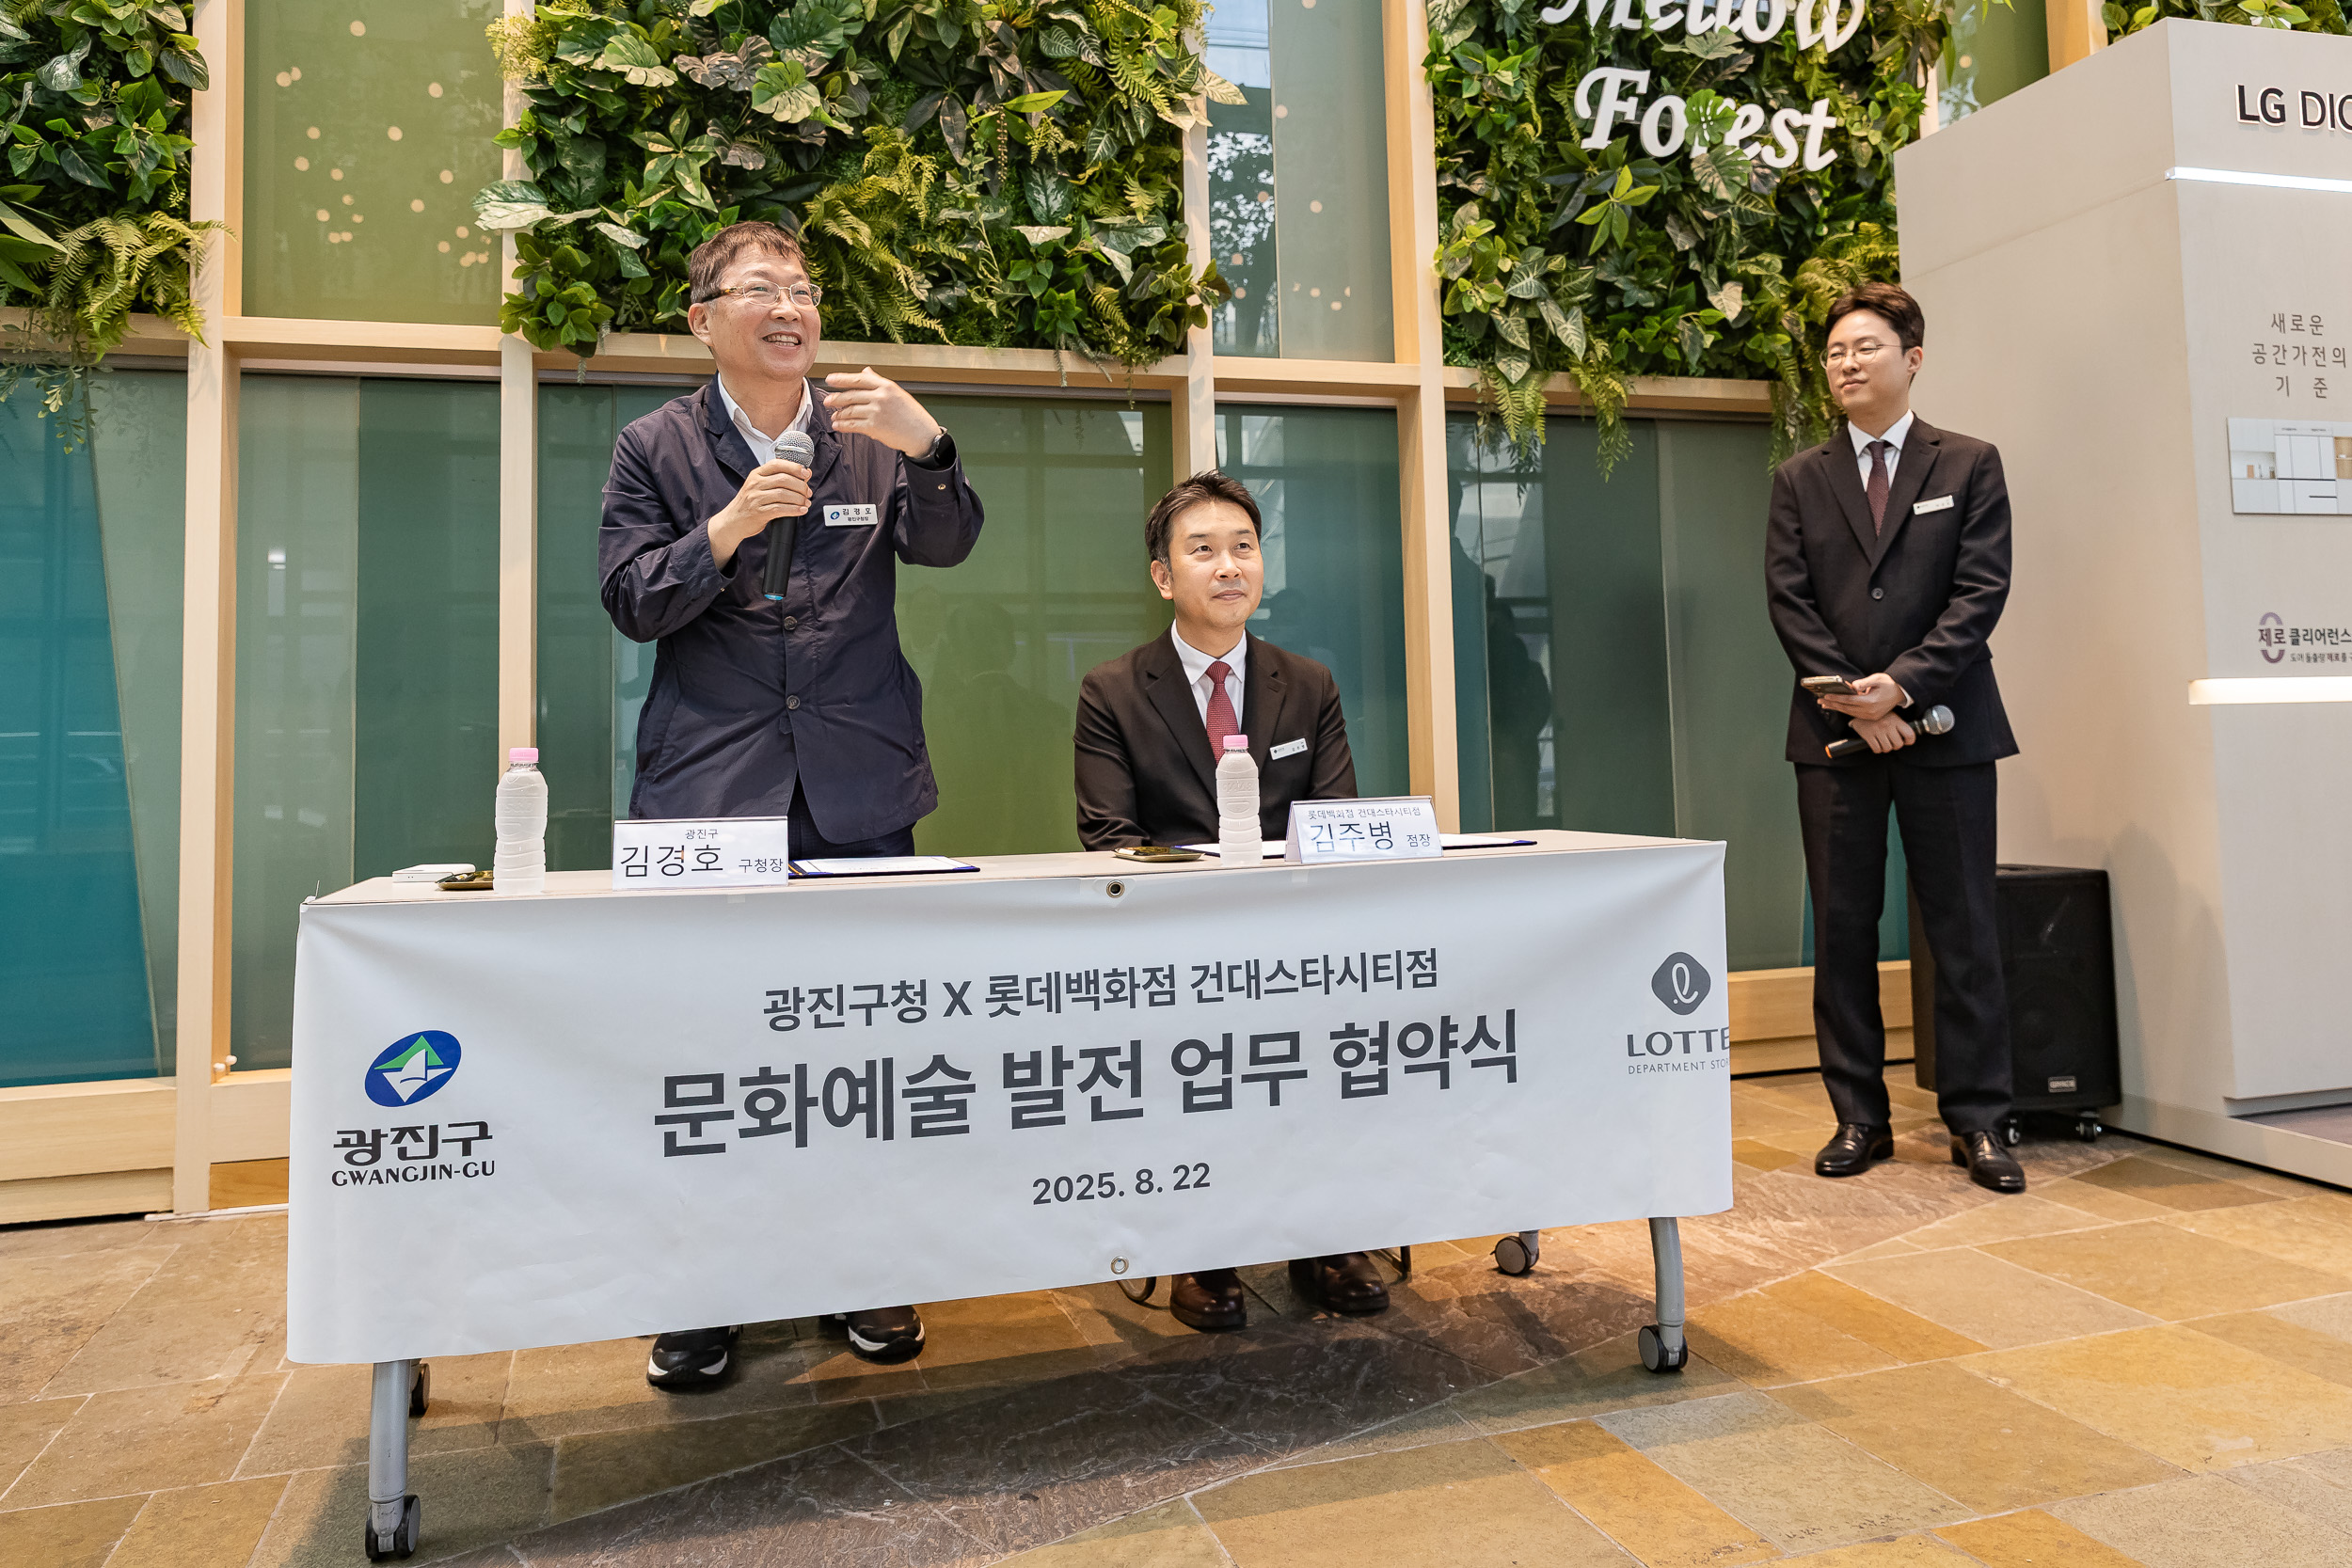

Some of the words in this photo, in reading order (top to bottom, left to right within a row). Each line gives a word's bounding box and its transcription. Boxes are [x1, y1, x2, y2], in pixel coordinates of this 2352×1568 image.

[2235, 84, 2286, 126] LG
[2271, 312, 2324, 336] 새로운
[2251, 342, 2346, 369] 공간가전의
[2258, 627, 2287, 647] 제로
[2288, 627, 2352, 646] 클리어런스
[1308, 809, 1355, 820] 롯데백화점
[1358, 806, 1421, 818] 건대스타시티점
[685, 829, 719, 840] 광진구
[1311, 820, 1393, 852] 김주병
[1406, 833, 1431, 847] 점장
[620, 844, 723, 878] 김경호
[739, 858, 784, 873] 구청장
[763, 979, 928, 1032] 광진구청
[943, 980, 973, 1018] X
[985, 963, 1176, 1019] 롯데백화점
[1190, 947, 1438, 1004] 건대스타시티점
[1627, 1026, 1730, 1057] LOTTE
[654, 1053, 977, 1158] 문화예술
[1002, 1039, 1144, 1131] 발전
[1170, 1031, 1309, 1114] 업무
[1329, 1008, 1518, 1100] 협약식
[1628, 1061, 1706, 1074] DEPARTMENT
[333, 1120, 493, 1166] 광진구
[331, 1160, 495, 1187] GWANGJIN-GU
[1032, 1171, 1125, 1206] 2025.
[1135, 1168, 1164, 1195] 8.
[1172, 1162, 1211, 1191] 22
